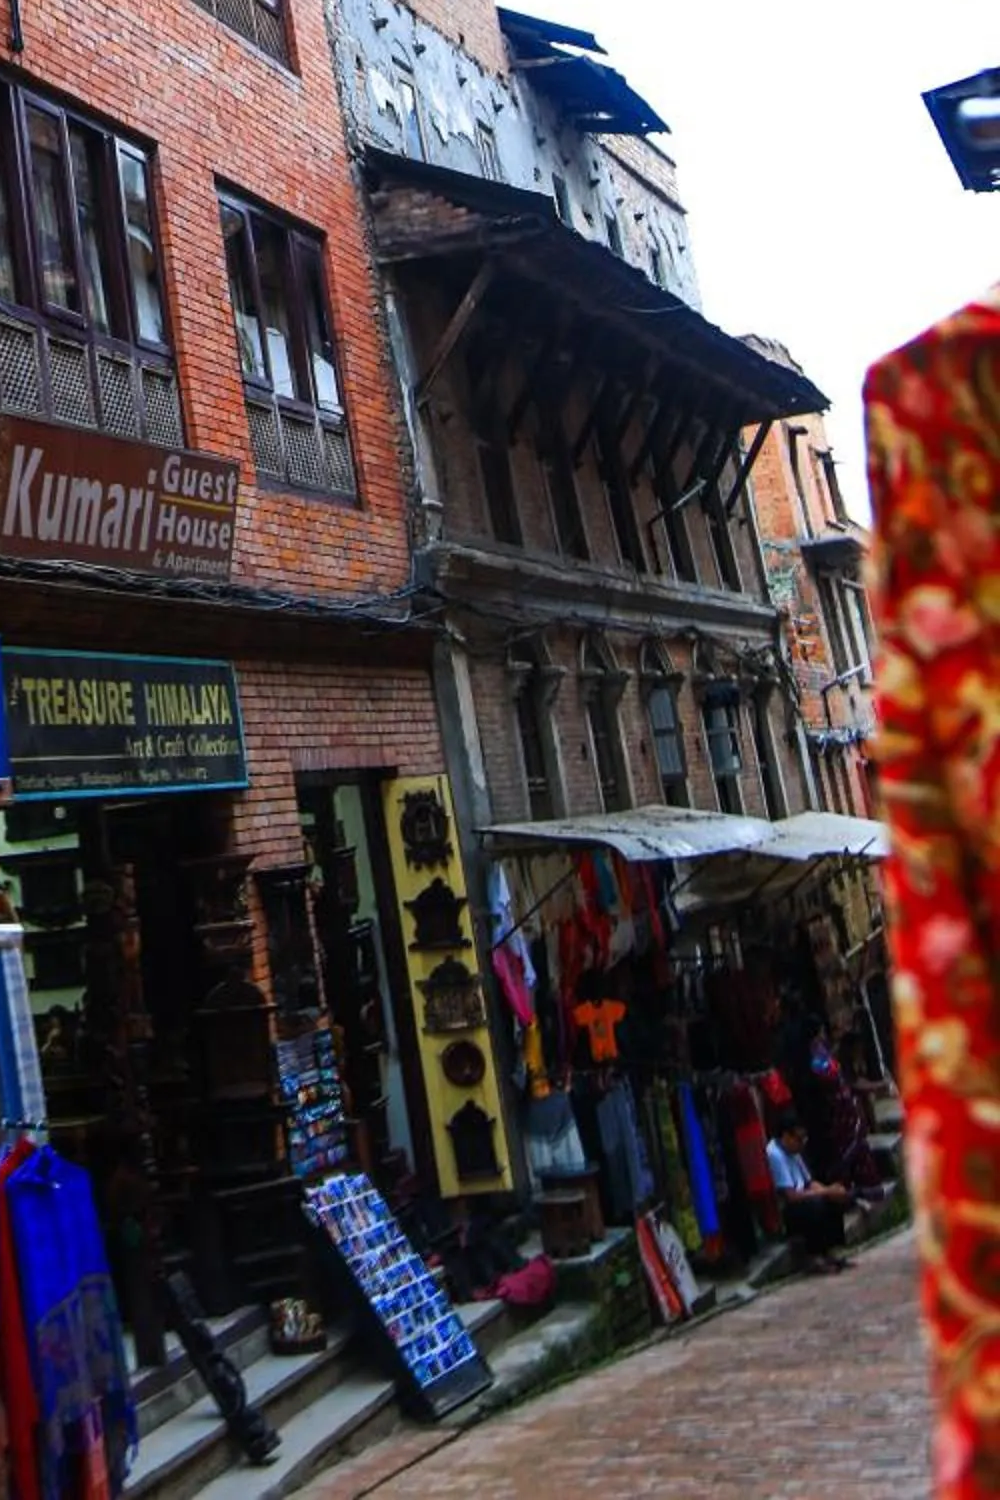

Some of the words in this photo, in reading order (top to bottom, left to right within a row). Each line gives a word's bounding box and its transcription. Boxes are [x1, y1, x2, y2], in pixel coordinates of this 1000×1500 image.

[2, 444, 157, 552] Kumari
[162, 455, 237, 503] Guest
[156, 504, 231, 550] House
[164, 551, 228, 575] Apartment
[22, 677, 136, 726] TREASURE
[143, 682, 234, 726] HIMALAYA
